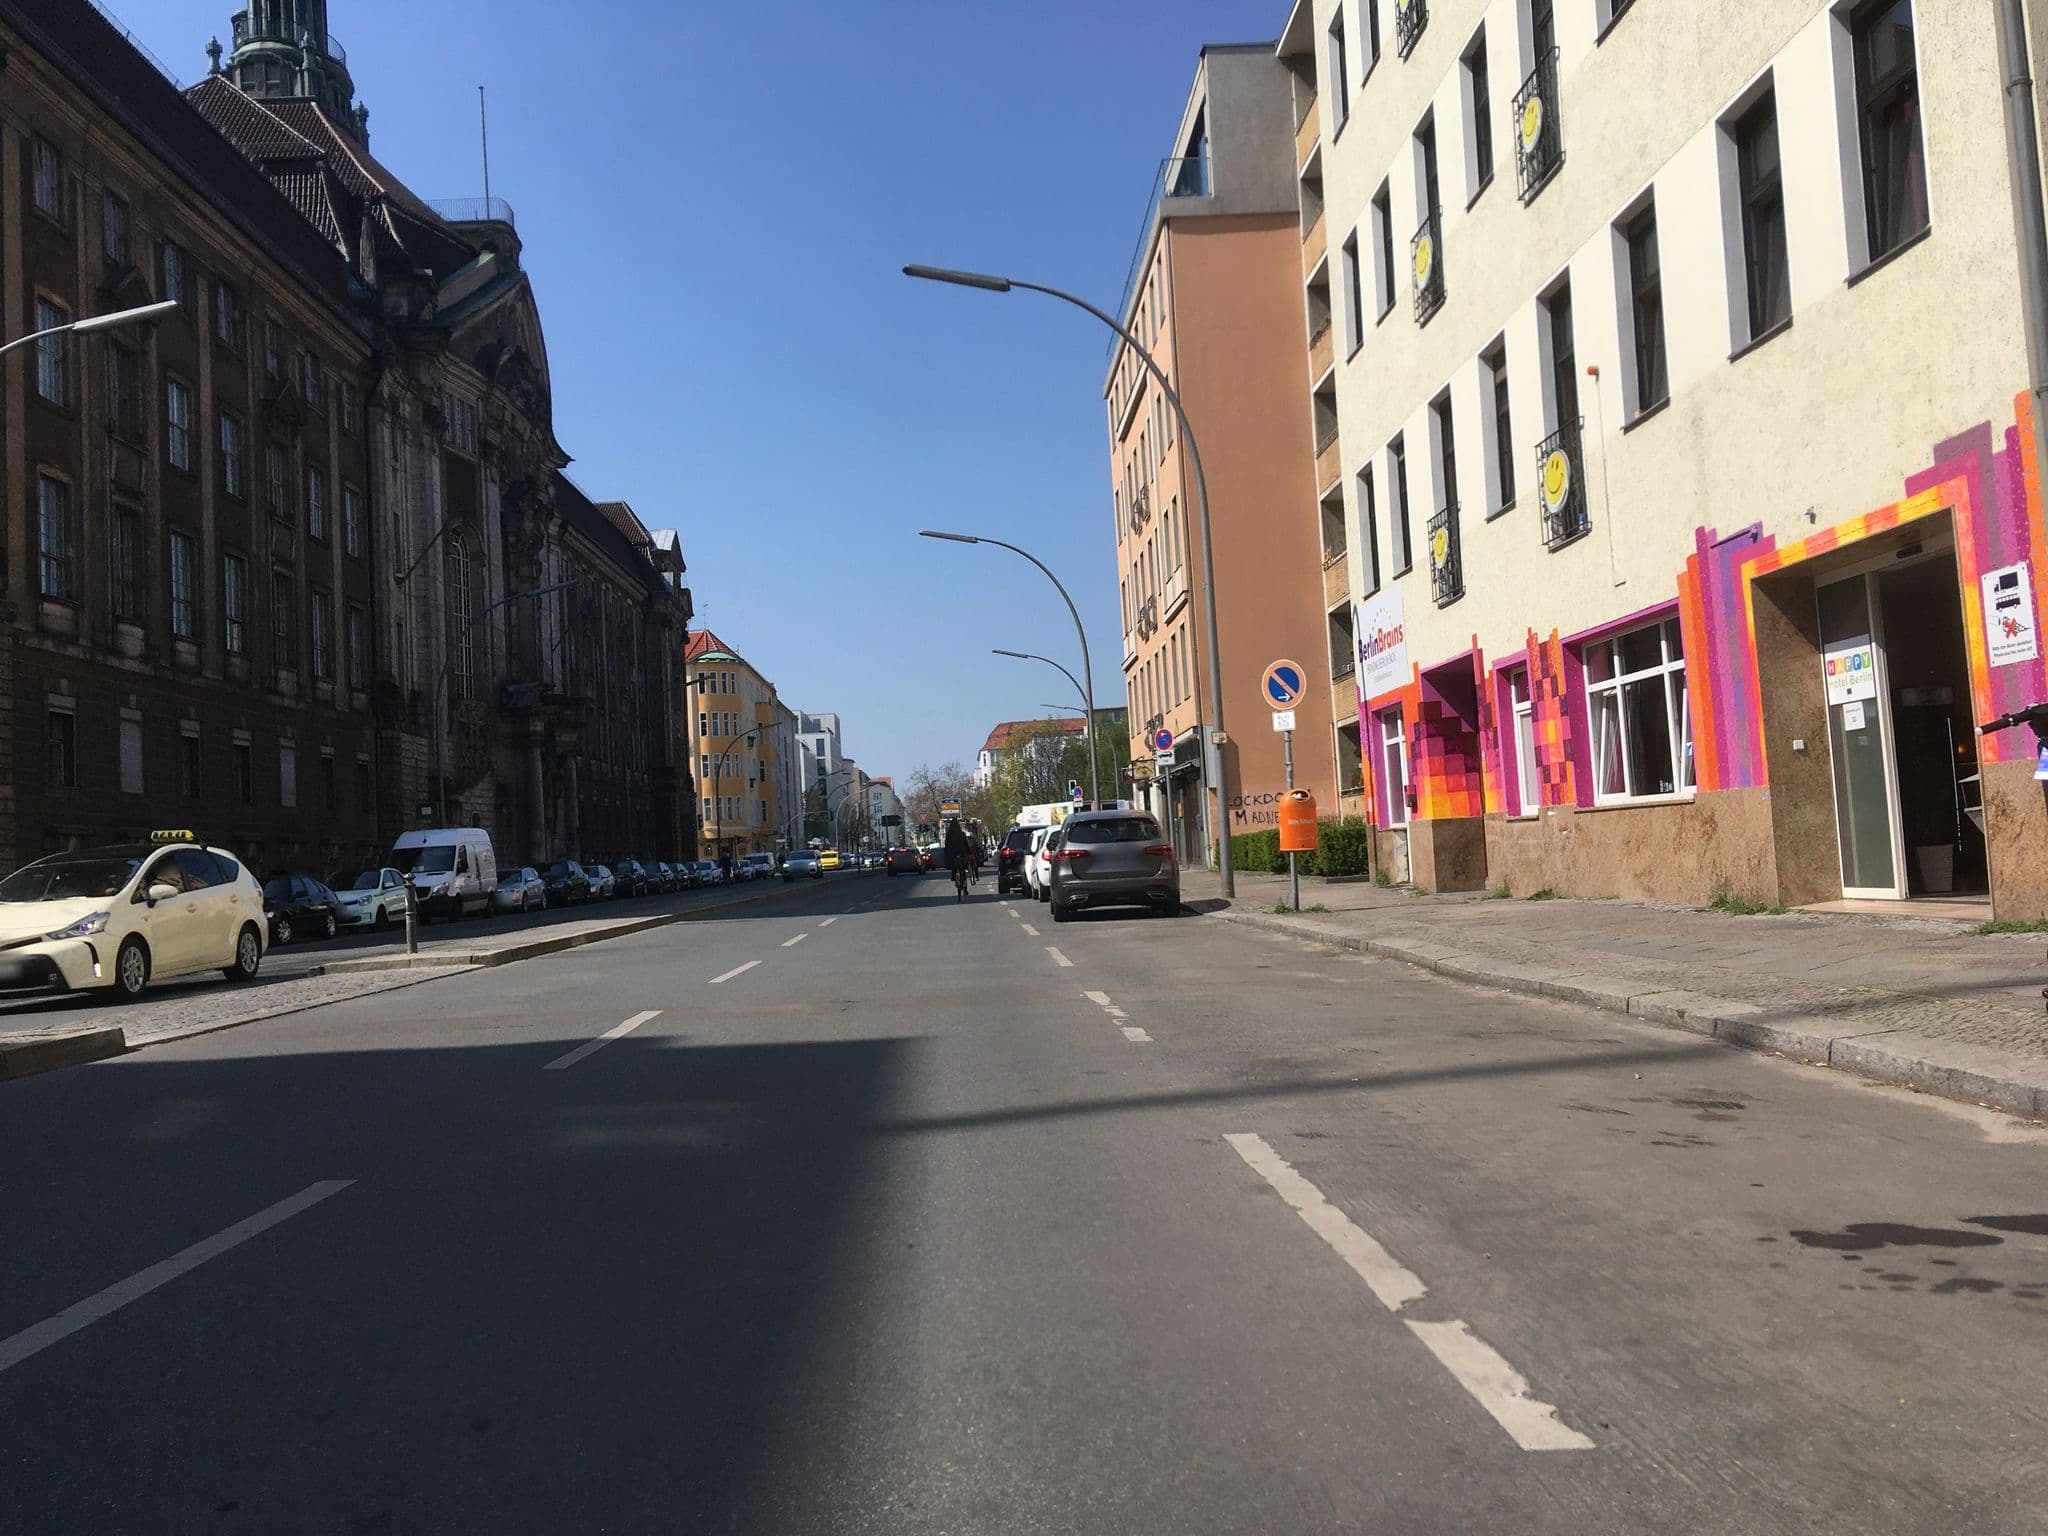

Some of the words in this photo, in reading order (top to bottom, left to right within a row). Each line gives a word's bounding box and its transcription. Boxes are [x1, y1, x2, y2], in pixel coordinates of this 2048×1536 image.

[1827, 653, 1870, 676] HAPPY
[1828, 676, 1848, 689] Hotel
[1849, 672, 1873, 685] Berlin
